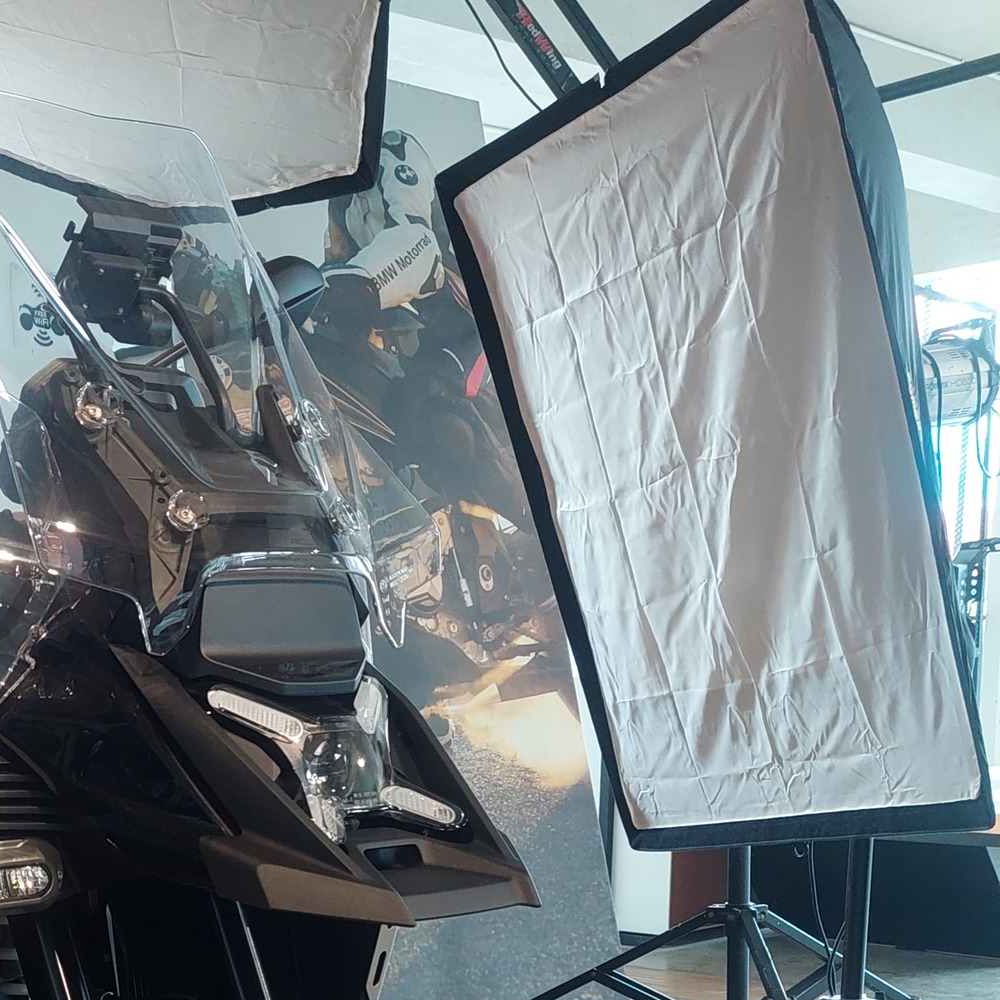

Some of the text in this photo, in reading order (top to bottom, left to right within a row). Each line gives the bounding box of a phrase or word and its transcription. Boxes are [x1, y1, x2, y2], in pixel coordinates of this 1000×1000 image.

[373, 233, 432, 290] BMW Motorrad
[34, 310, 47, 319] FREE
